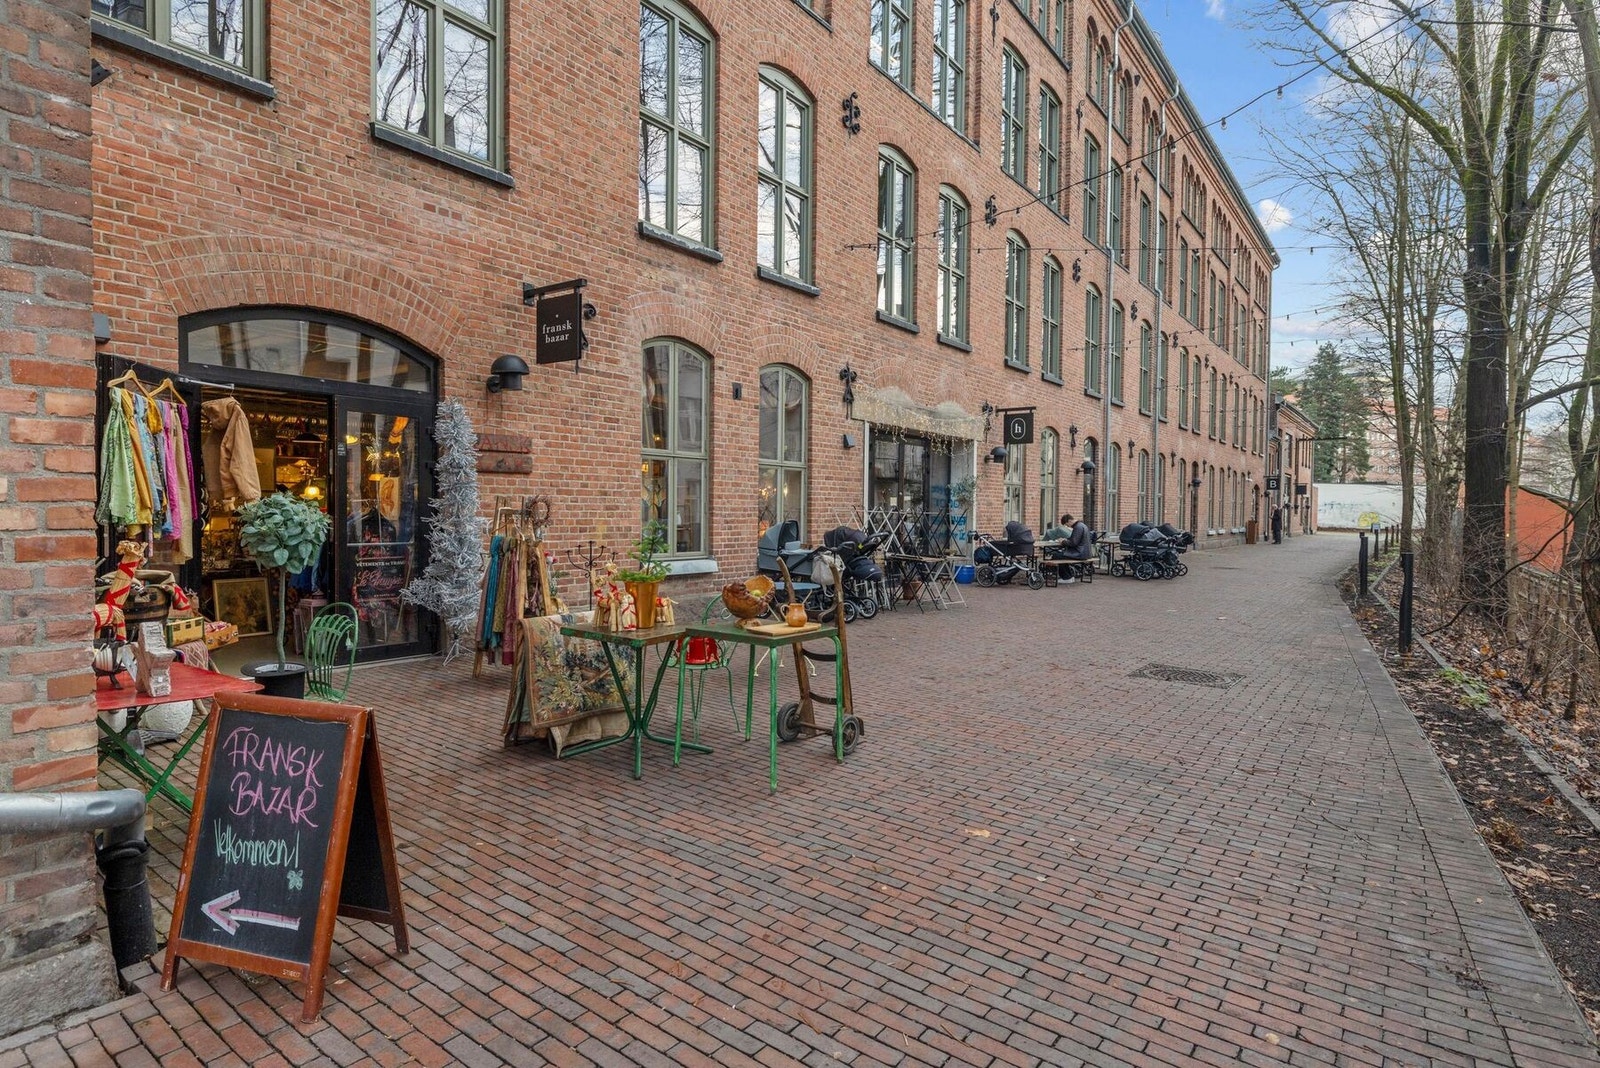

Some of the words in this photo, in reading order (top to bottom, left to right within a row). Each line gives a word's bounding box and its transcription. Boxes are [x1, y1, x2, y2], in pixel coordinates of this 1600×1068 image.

[542, 320, 573, 335] fransk
[545, 333, 570, 344] bazar
[1014, 423, 1022, 433] h
[1269, 480, 1277, 488] B
[222, 726, 326, 788] FRANSK
[228, 771, 319, 828] BAZAR
